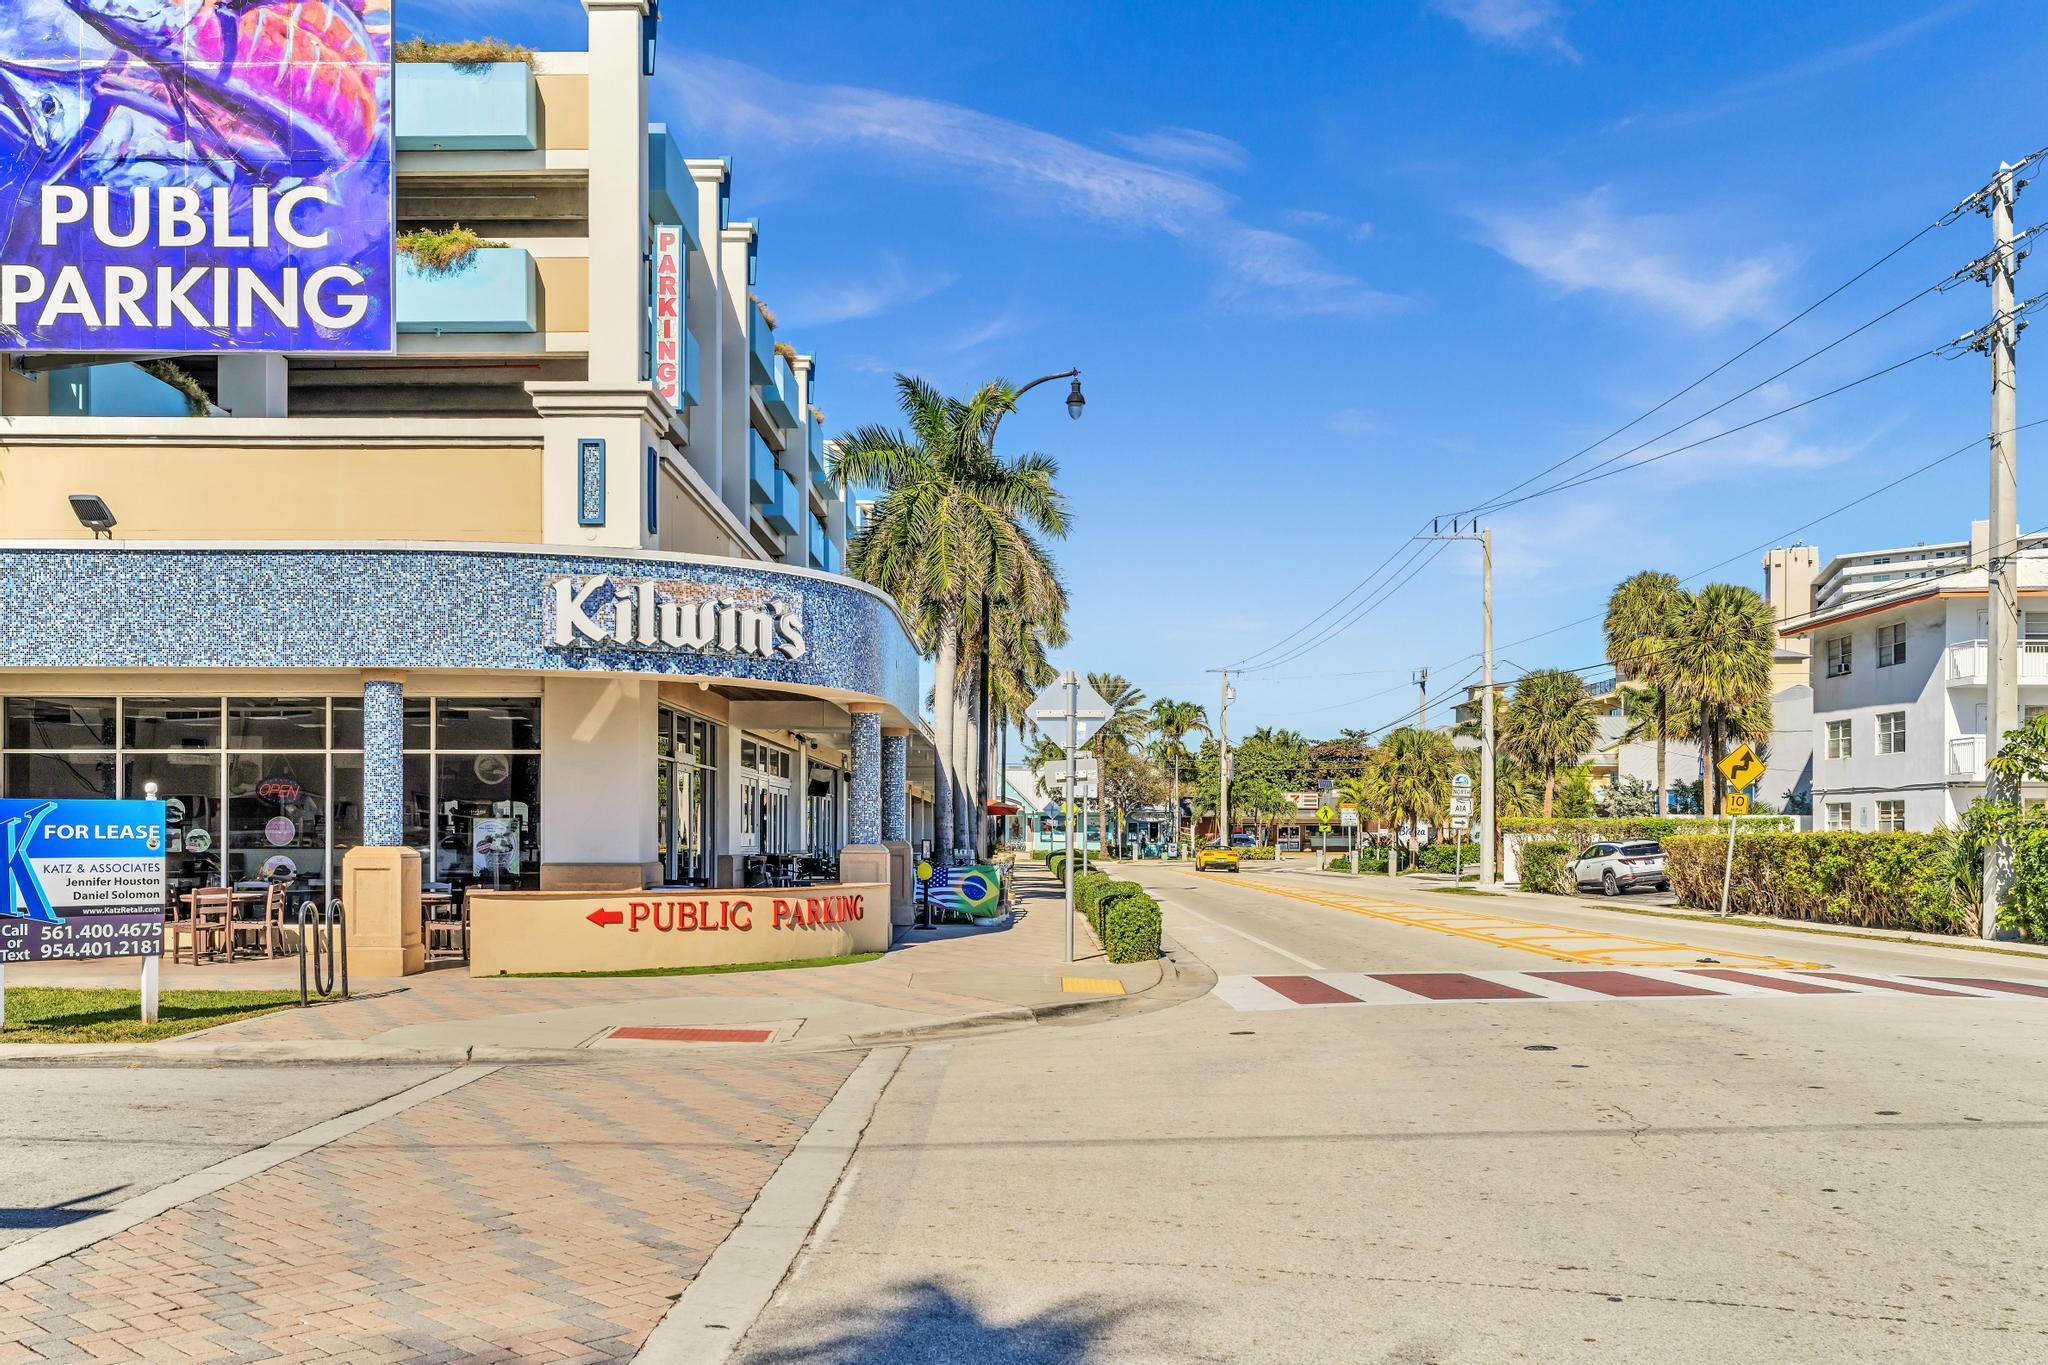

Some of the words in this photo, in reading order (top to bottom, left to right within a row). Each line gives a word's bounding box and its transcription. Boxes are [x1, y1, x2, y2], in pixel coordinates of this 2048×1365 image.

[41, 185, 329, 249] PUBLIC
[1, 264, 369, 329] PARKING
[657, 232, 677, 382] PARKING
[552, 574, 806, 660] Kilwin's
[259, 783, 300, 799] OPEN
[1731, 796, 1744, 806] 10
[44, 824, 89, 839] FOR
[95, 824, 160, 839] LEASE
[44, 863, 72, 873] KATZ
[77, 863, 87, 873] &
[90, 863, 160, 873] ASSOCIATES
[66, 877, 111, 887] Jennifer
[114, 876, 160, 886] Houston
[73, 891, 109, 900] Daniel
[112, 890, 160, 900] Solomon
[83, 906, 160, 915] www.KatzRetail.com
[628, 899, 752, 931] PUBLIC
[772, 894, 864, 928] PARKING
[1, 924, 28, 936] Call
[41, 922, 162, 941] 561.400.4675
[7, 938, 23, 949] or
[40, 940, 160, 959] 954.401.2181
[0, 949, 31, 961] Text
